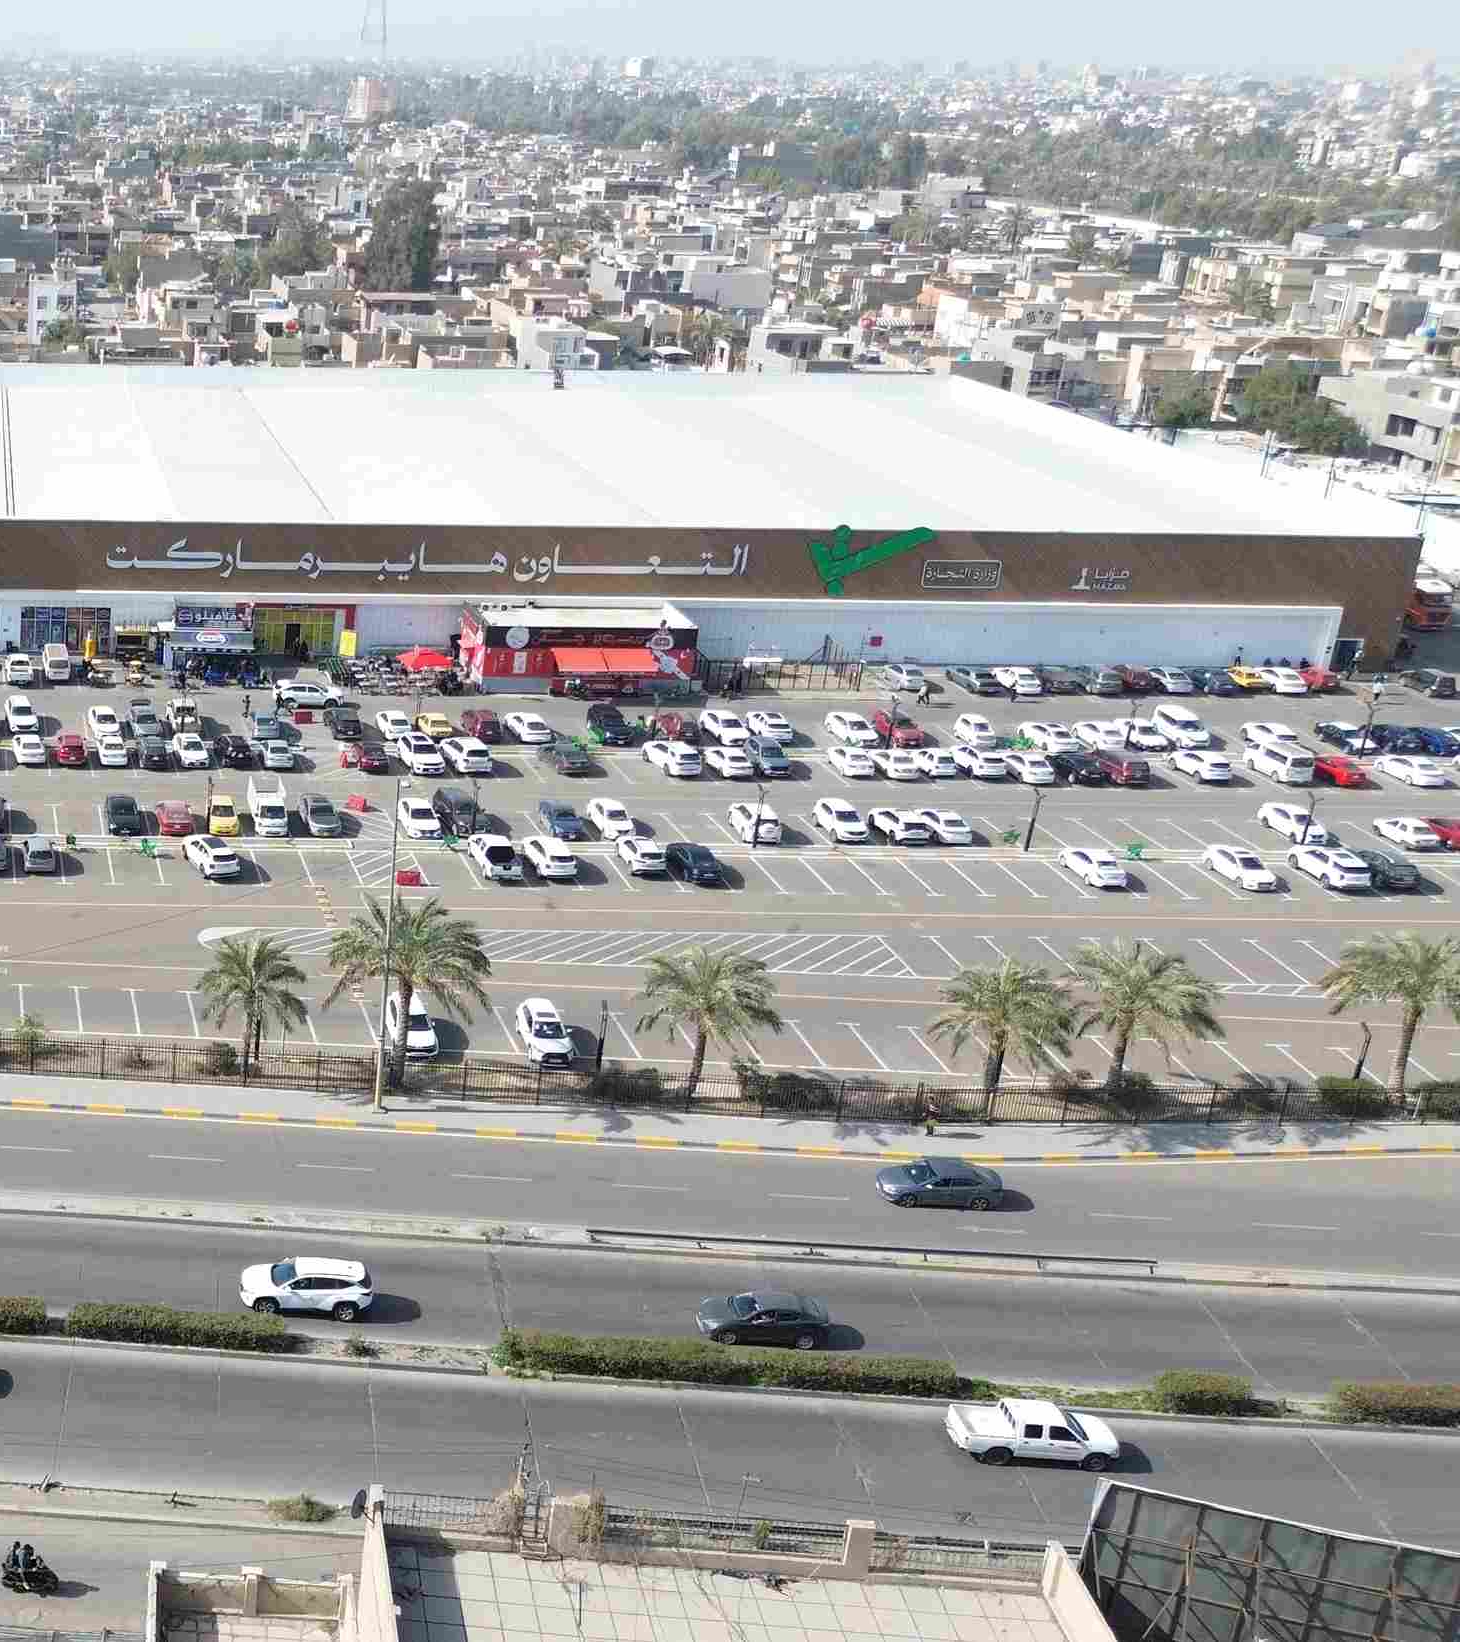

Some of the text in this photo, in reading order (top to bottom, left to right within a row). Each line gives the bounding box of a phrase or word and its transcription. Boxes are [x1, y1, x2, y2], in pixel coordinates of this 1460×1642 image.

[106, 537, 749, 583] التعاون هايبر ماركت
